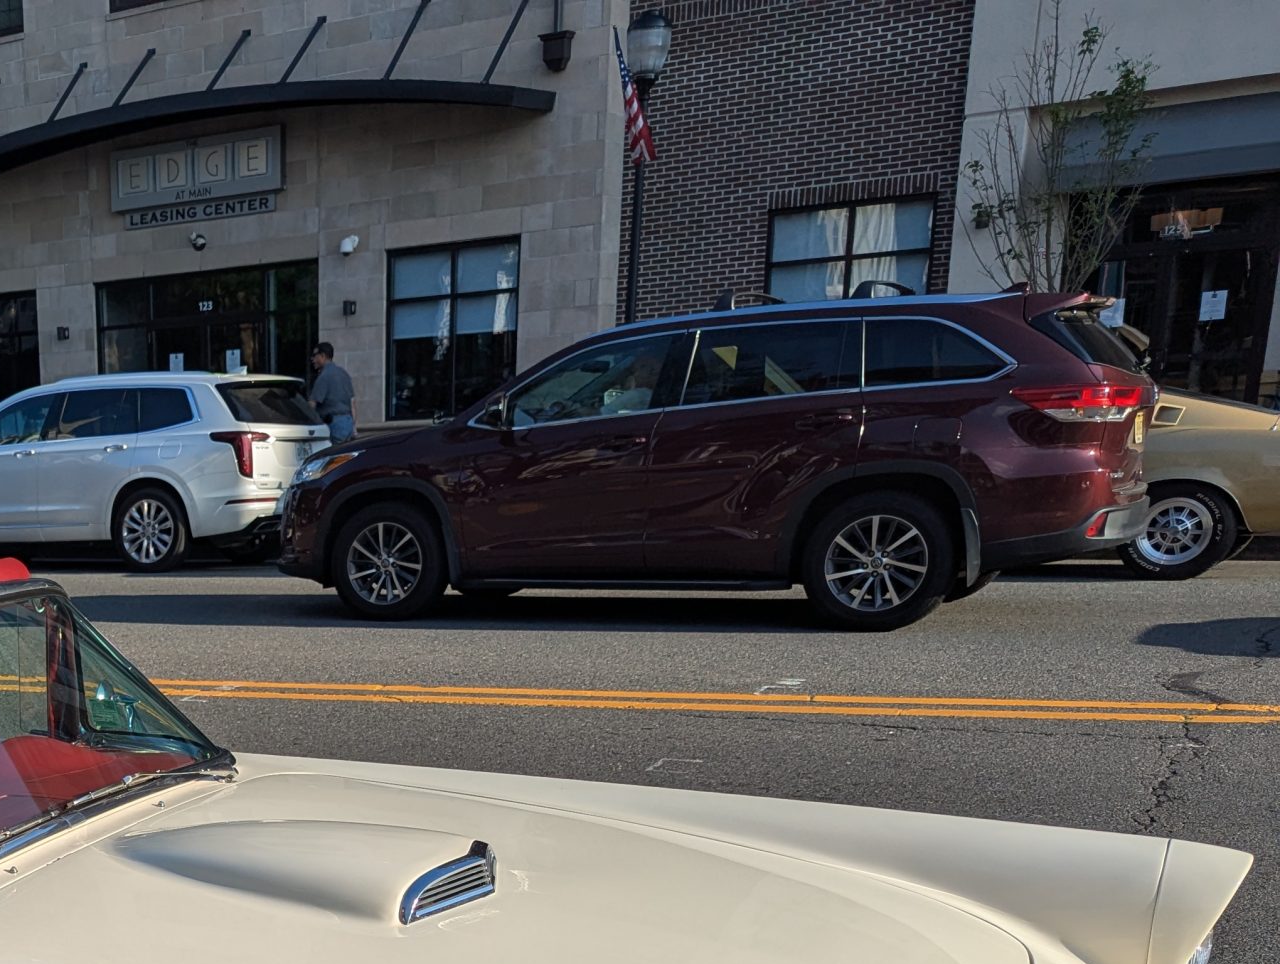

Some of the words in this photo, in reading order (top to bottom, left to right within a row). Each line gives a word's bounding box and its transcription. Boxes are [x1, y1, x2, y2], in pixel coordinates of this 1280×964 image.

[128, 143, 260, 190] EDGE
[175, 190, 186, 201] AT
[188, 186, 212, 199] MAIN
[129, 206, 197, 227] LEASING
[202, 197, 270, 217] CENTER
[199, 301, 213, 311] 123
